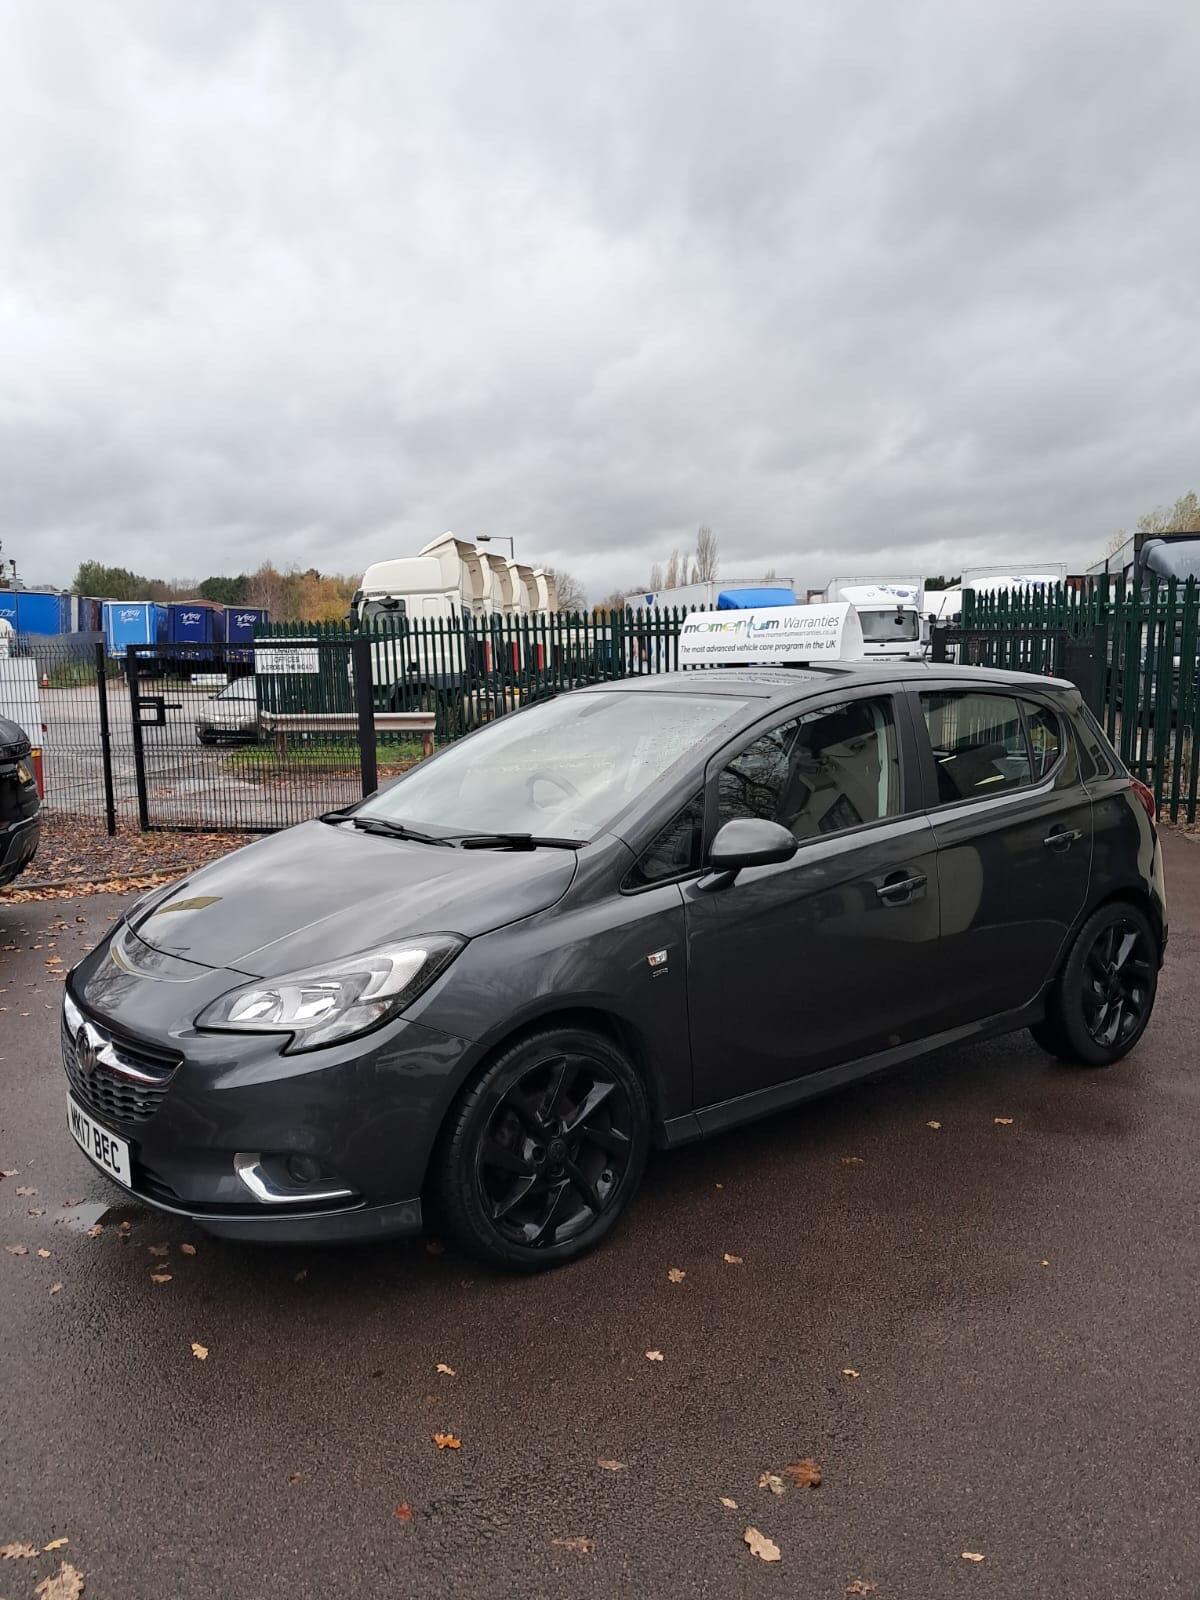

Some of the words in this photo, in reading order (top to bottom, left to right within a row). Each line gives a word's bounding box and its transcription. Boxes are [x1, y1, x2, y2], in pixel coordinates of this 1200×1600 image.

[684, 615, 780, 639] momentum
[784, 615, 839, 629] Warranties
[681, 645, 690, 653] The
[692, 645, 705, 653] most
[706, 643, 736, 652] advanced
[737, 642, 758, 651] vehicle
[759, 643, 774, 651] care
[775, 642, 803, 652] program
[805, 641, 812, 649] in
[812, 640, 824, 649] the
[825, 640, 836, 649] UK
[93, 1126, 121, 1174] BEC
